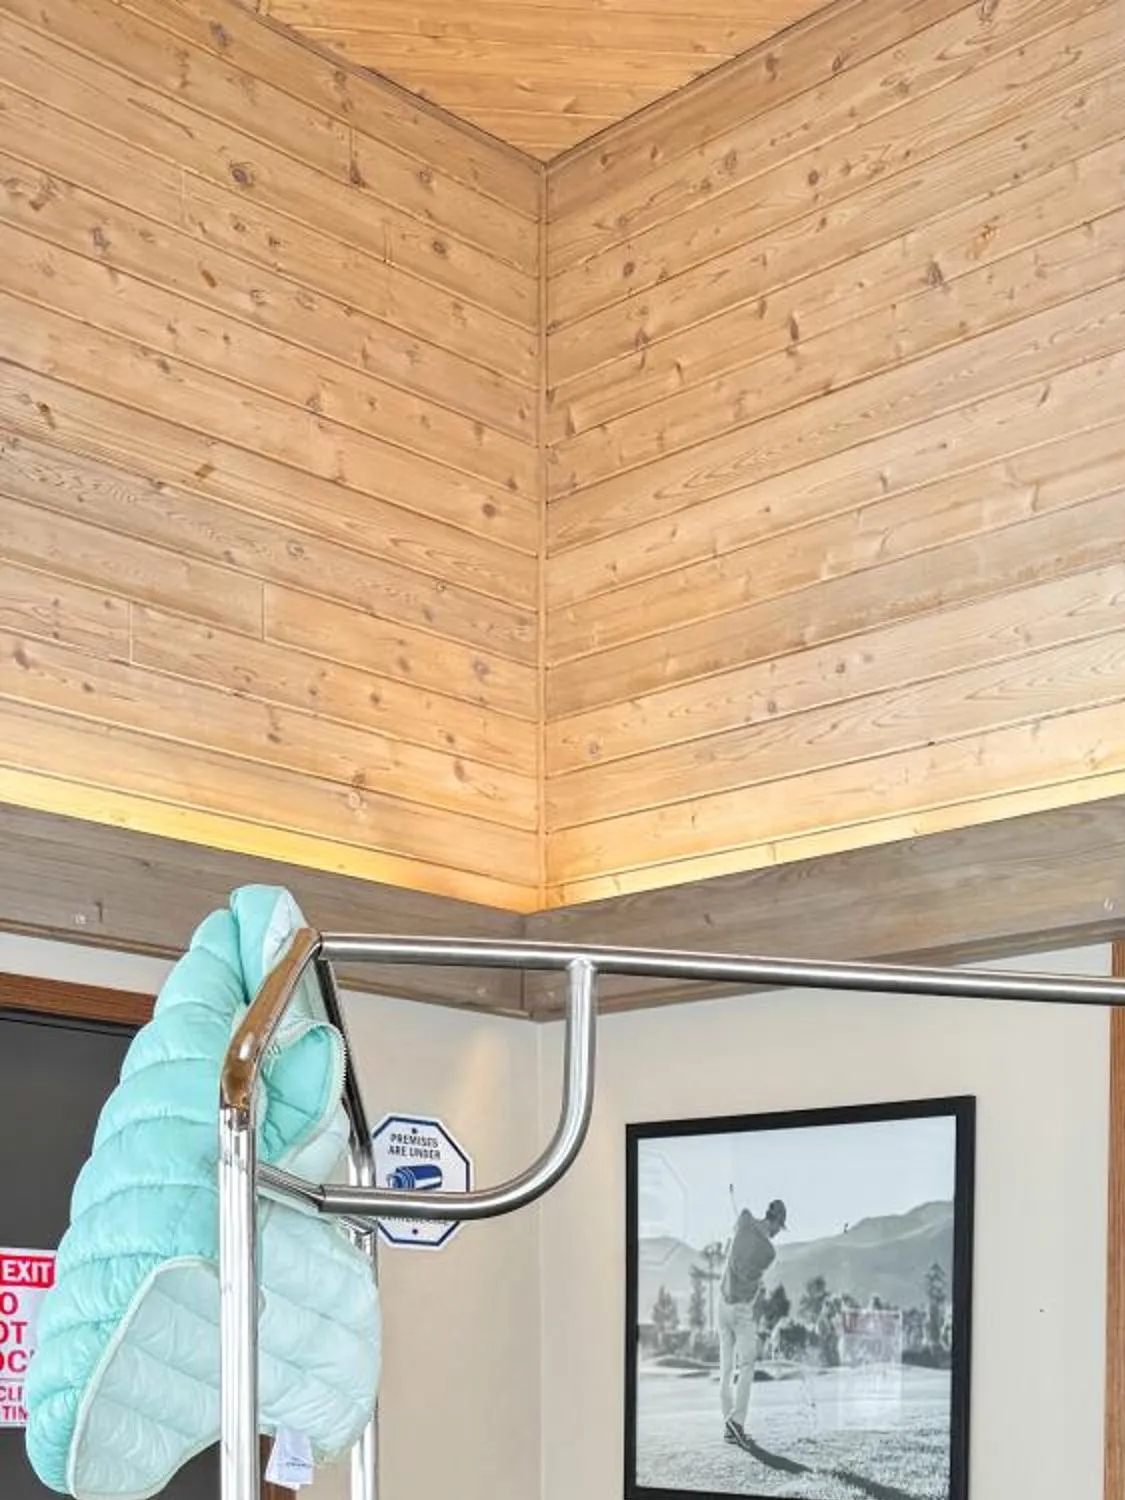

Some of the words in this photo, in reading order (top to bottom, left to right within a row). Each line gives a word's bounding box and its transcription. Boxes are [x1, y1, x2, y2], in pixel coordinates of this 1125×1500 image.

[389, 1132, 439, 1149] PREMISES
[387, 1145, 407, 1157] ARE
[409, 1147, 441, 1161] UNDER
[2, 1259, 53, 1283] EXIT
